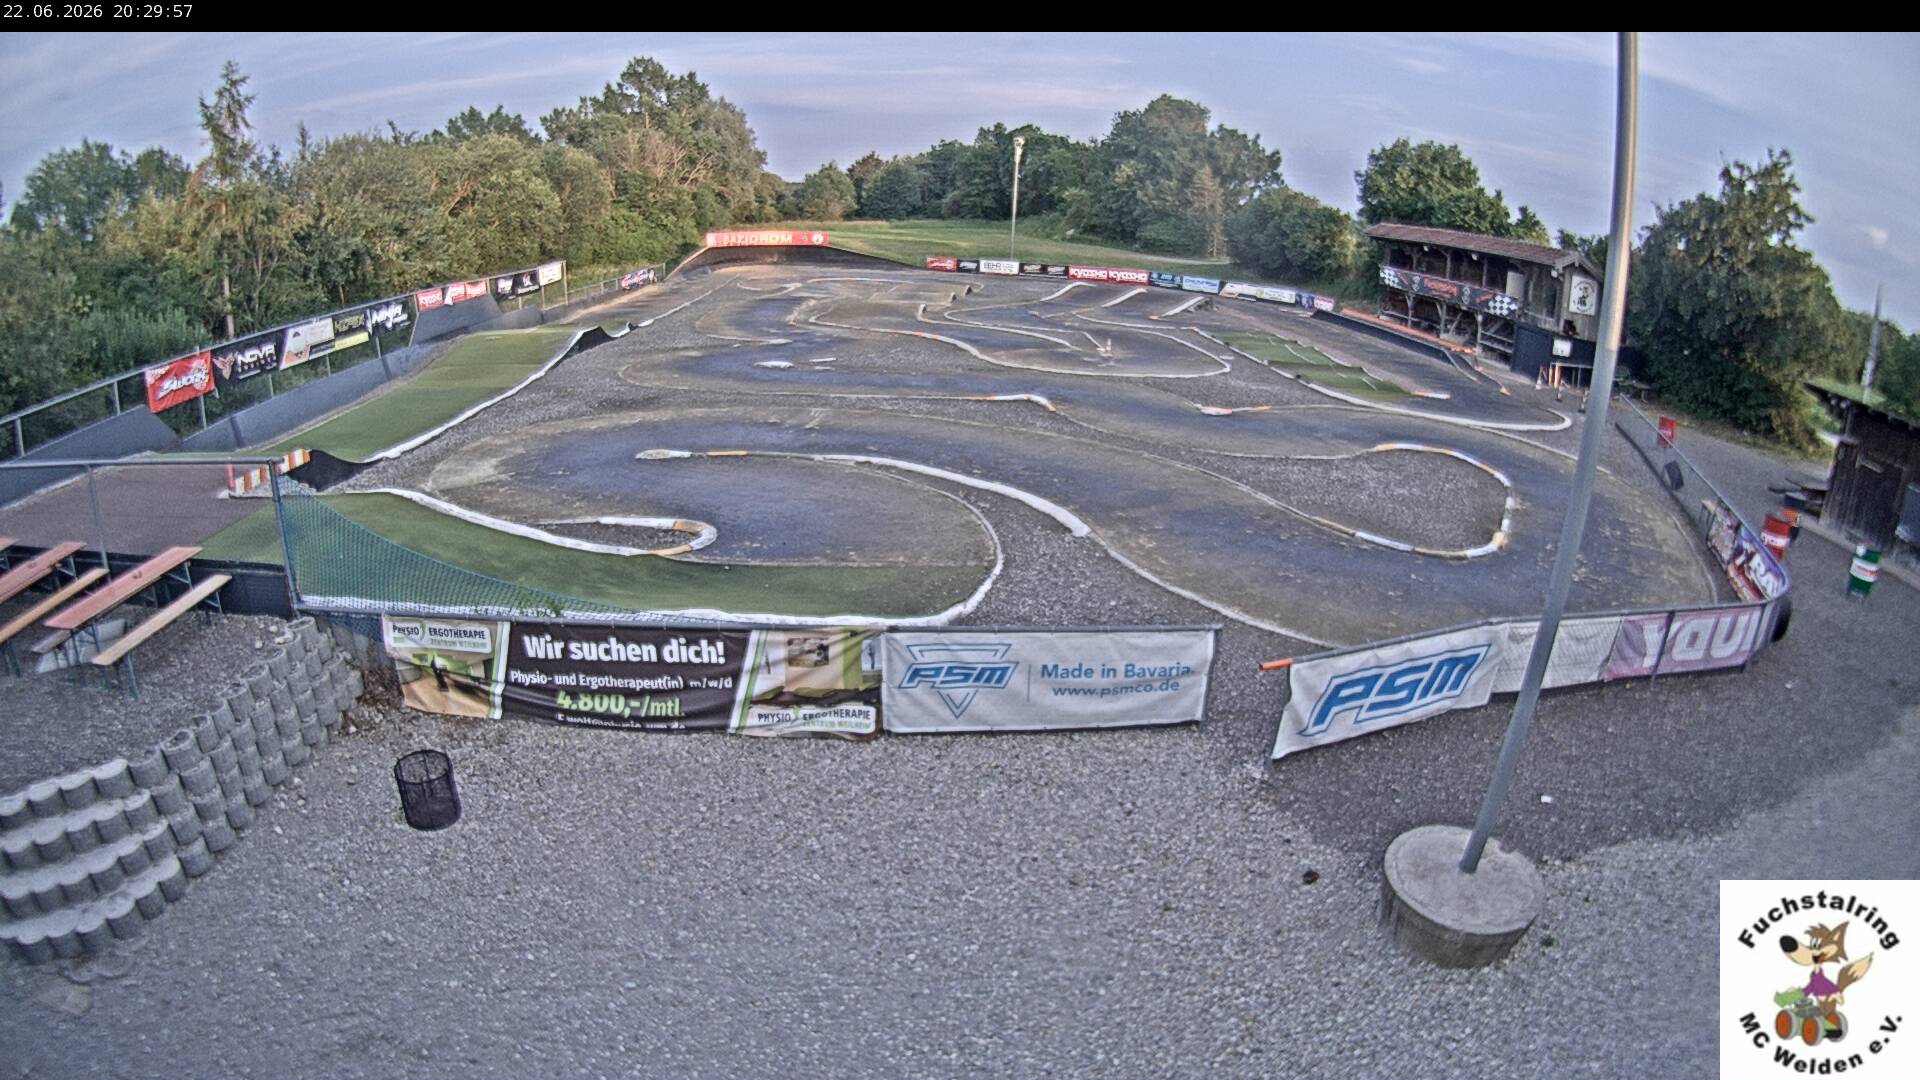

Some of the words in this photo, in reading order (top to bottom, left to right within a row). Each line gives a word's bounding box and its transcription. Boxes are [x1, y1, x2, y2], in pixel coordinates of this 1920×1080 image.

[428, 627, 486, 640] ERGOTHERAPIE
[523, 635, 564, 659] Wir
[570, 638, 657, 663] suchen
[662, 638, 726, 664] dich!
[903, 663, 1010, 686] PSM
[1041, 664, 1094, 679] Made
[1101, 663, 1118, 678] in
[1124, 662, 1191, 678] Bavaria
[510, 671, 552, 686] Physio-
[556, 674, 577, 686] und
[579, 674, 683, 690] Ergotherapeut(in)
[689, 676, 733, 689] m/w/d
[1053, 680, 1180, 697] www.psmco.de
[1308, 650, 1485, 729] PSM
[757, 712, 791, 722] PHYSIO
